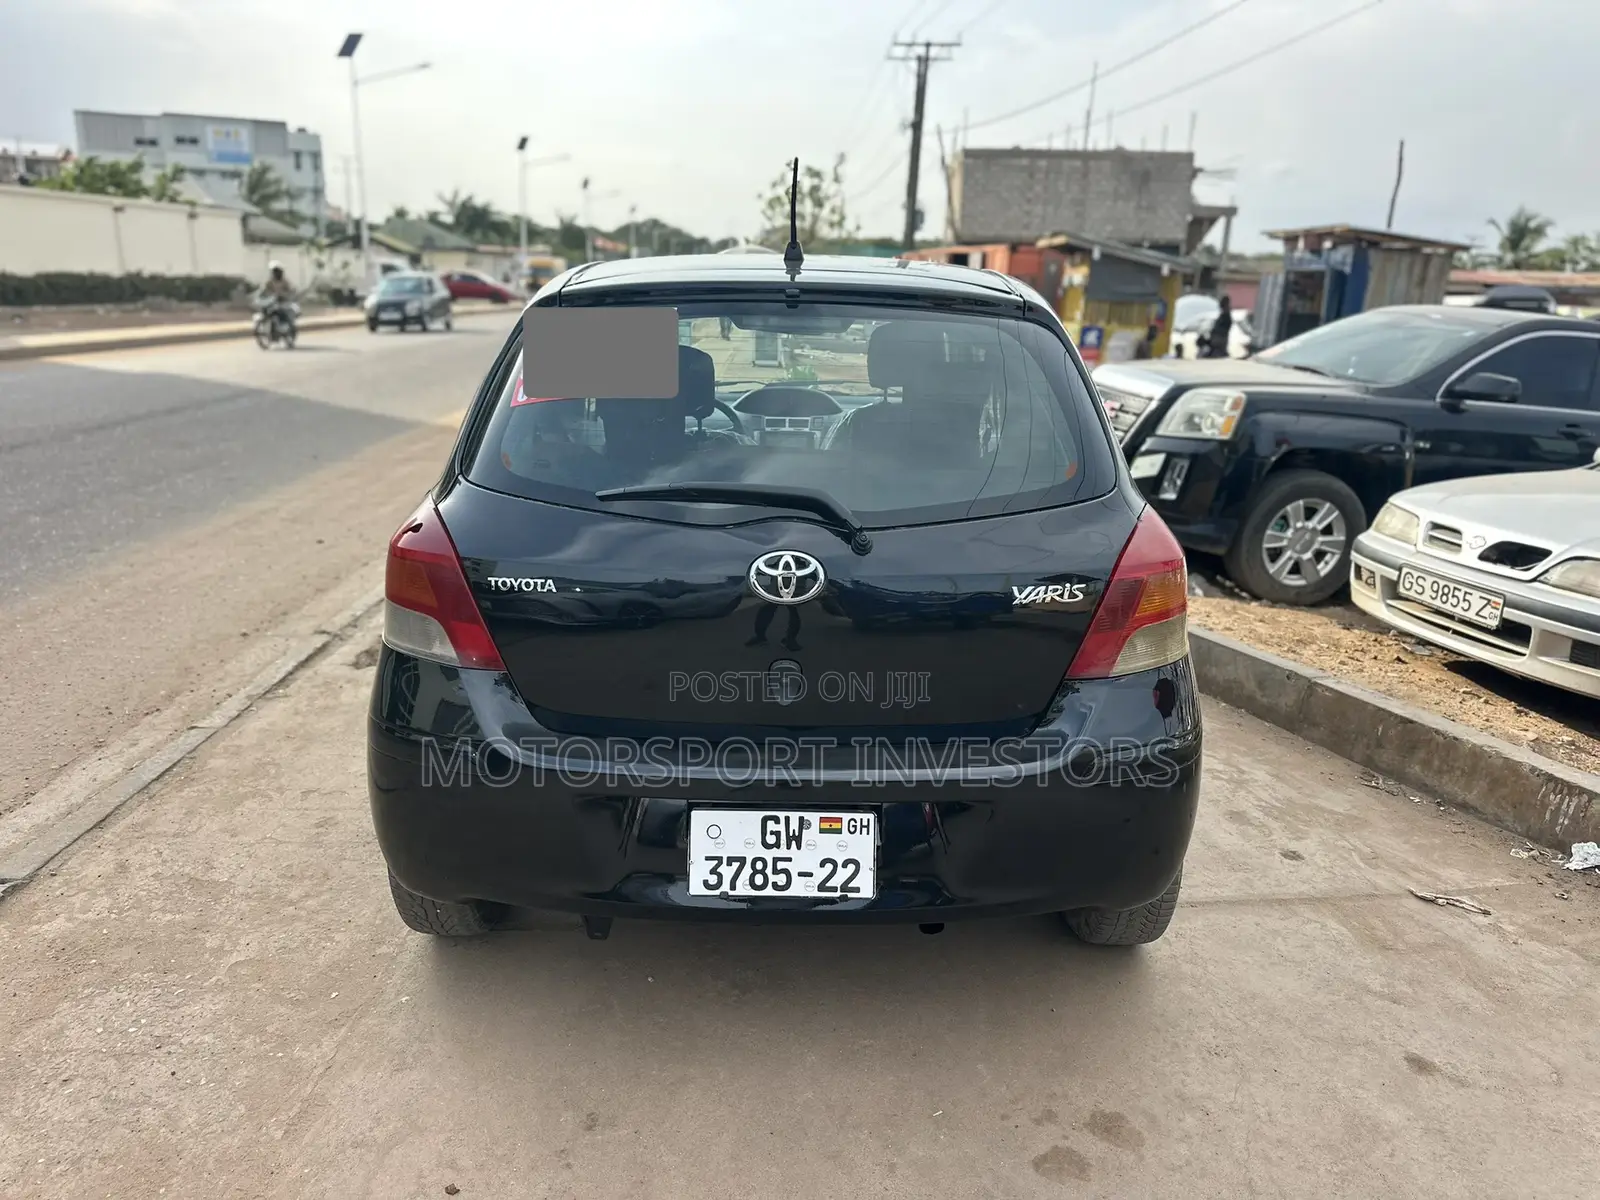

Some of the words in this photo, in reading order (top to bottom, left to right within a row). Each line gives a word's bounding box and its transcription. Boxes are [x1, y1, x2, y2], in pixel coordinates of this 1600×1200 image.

[487, 577, 557, 592] TOYOTA
[1402, 572, 1426, 596] GS
[1429, 580, 1473, 612] 9855
[1475, 596, 1491, 619] Z
[761, 815, 805, 850] GW
[847, 818, 870, 835] GH
[702, 856, 861, 893] 3785-22
